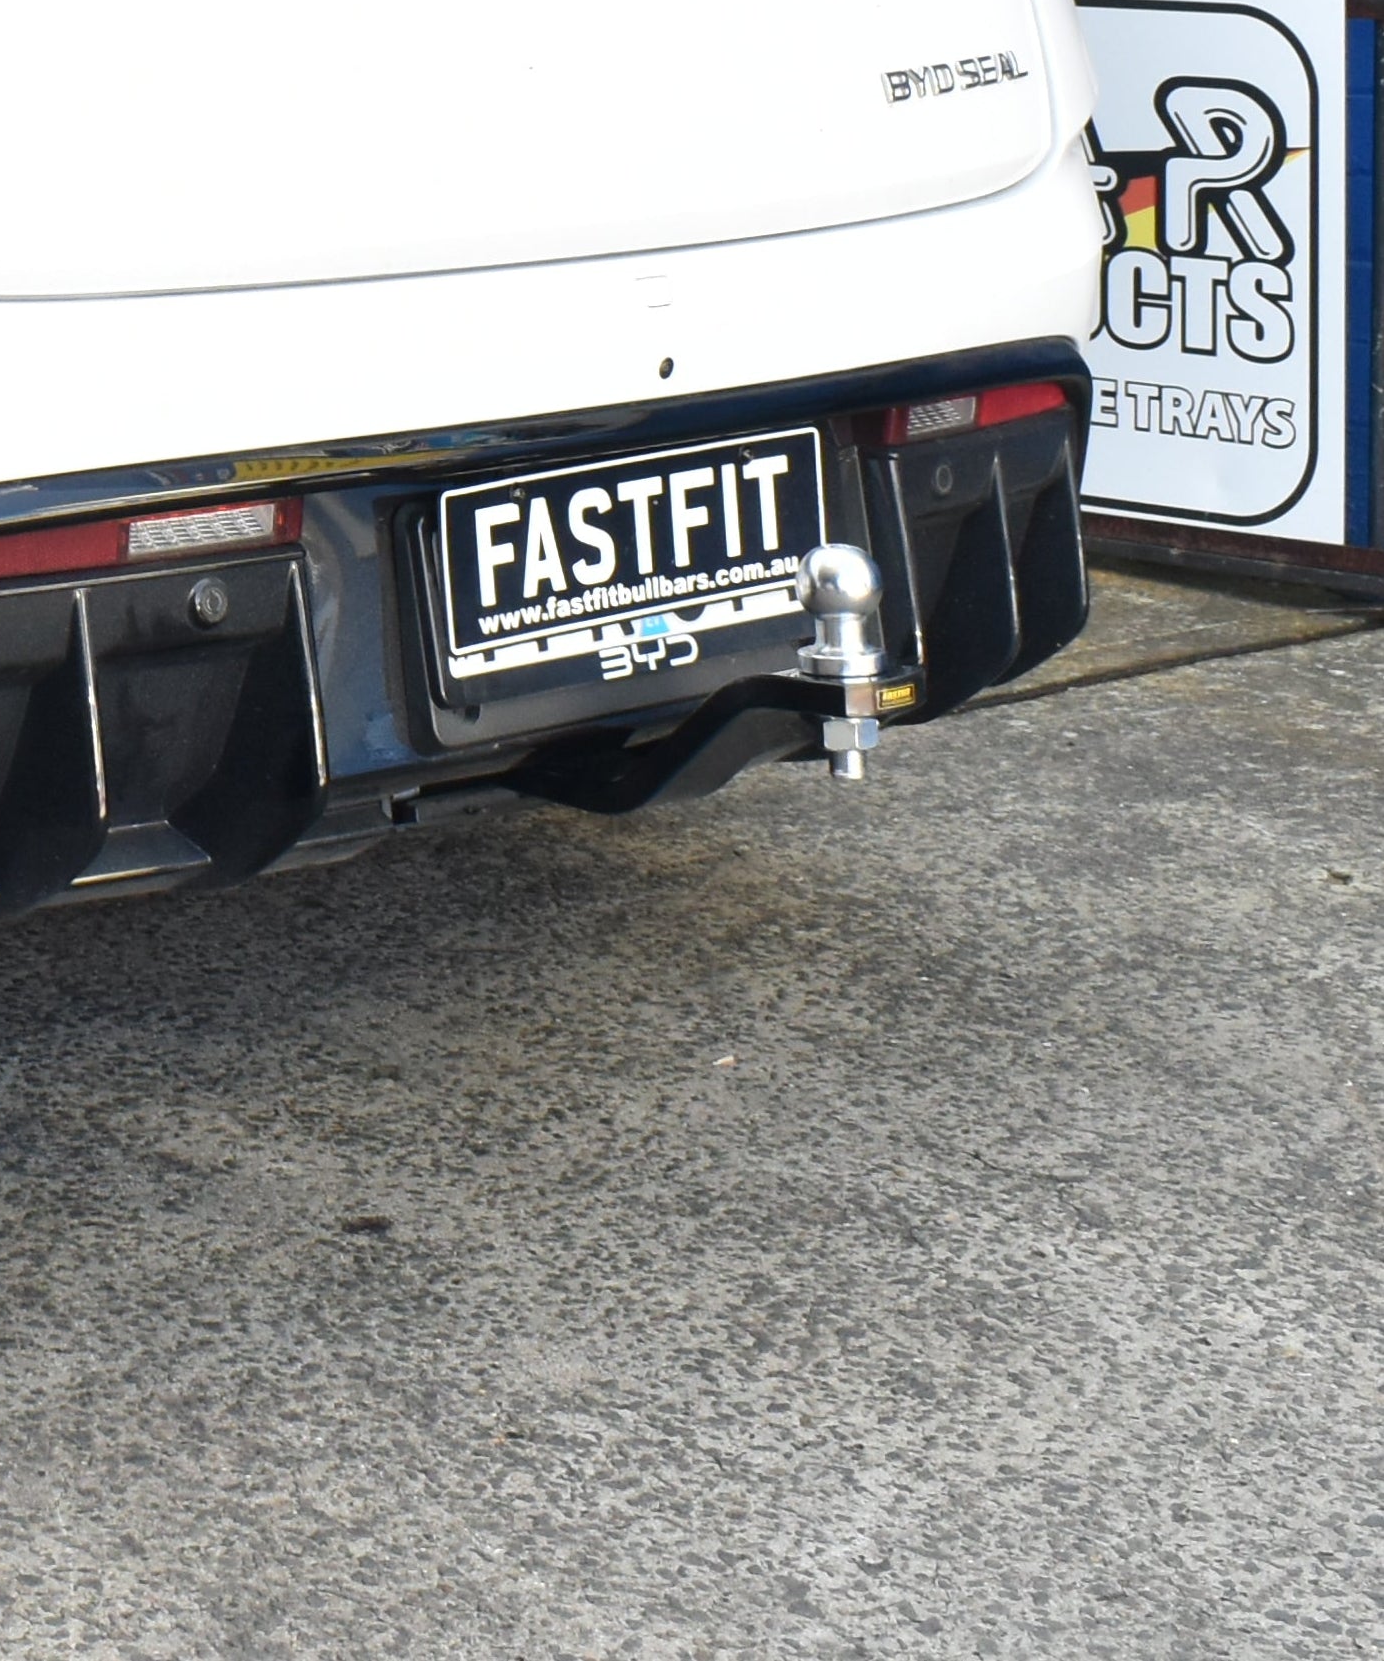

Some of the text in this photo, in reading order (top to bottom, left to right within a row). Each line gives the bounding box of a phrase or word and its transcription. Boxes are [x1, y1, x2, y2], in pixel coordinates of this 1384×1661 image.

[881, 50, 1029, 104] BYD SEAL
[1124, 380, 1296, 449] TRAYS
[474, 454, 789, 608] FASTFIT
[478, 555, 799, 636] www.fastfitbullbars.com.au
[598, 632, 700, 681] BYD
